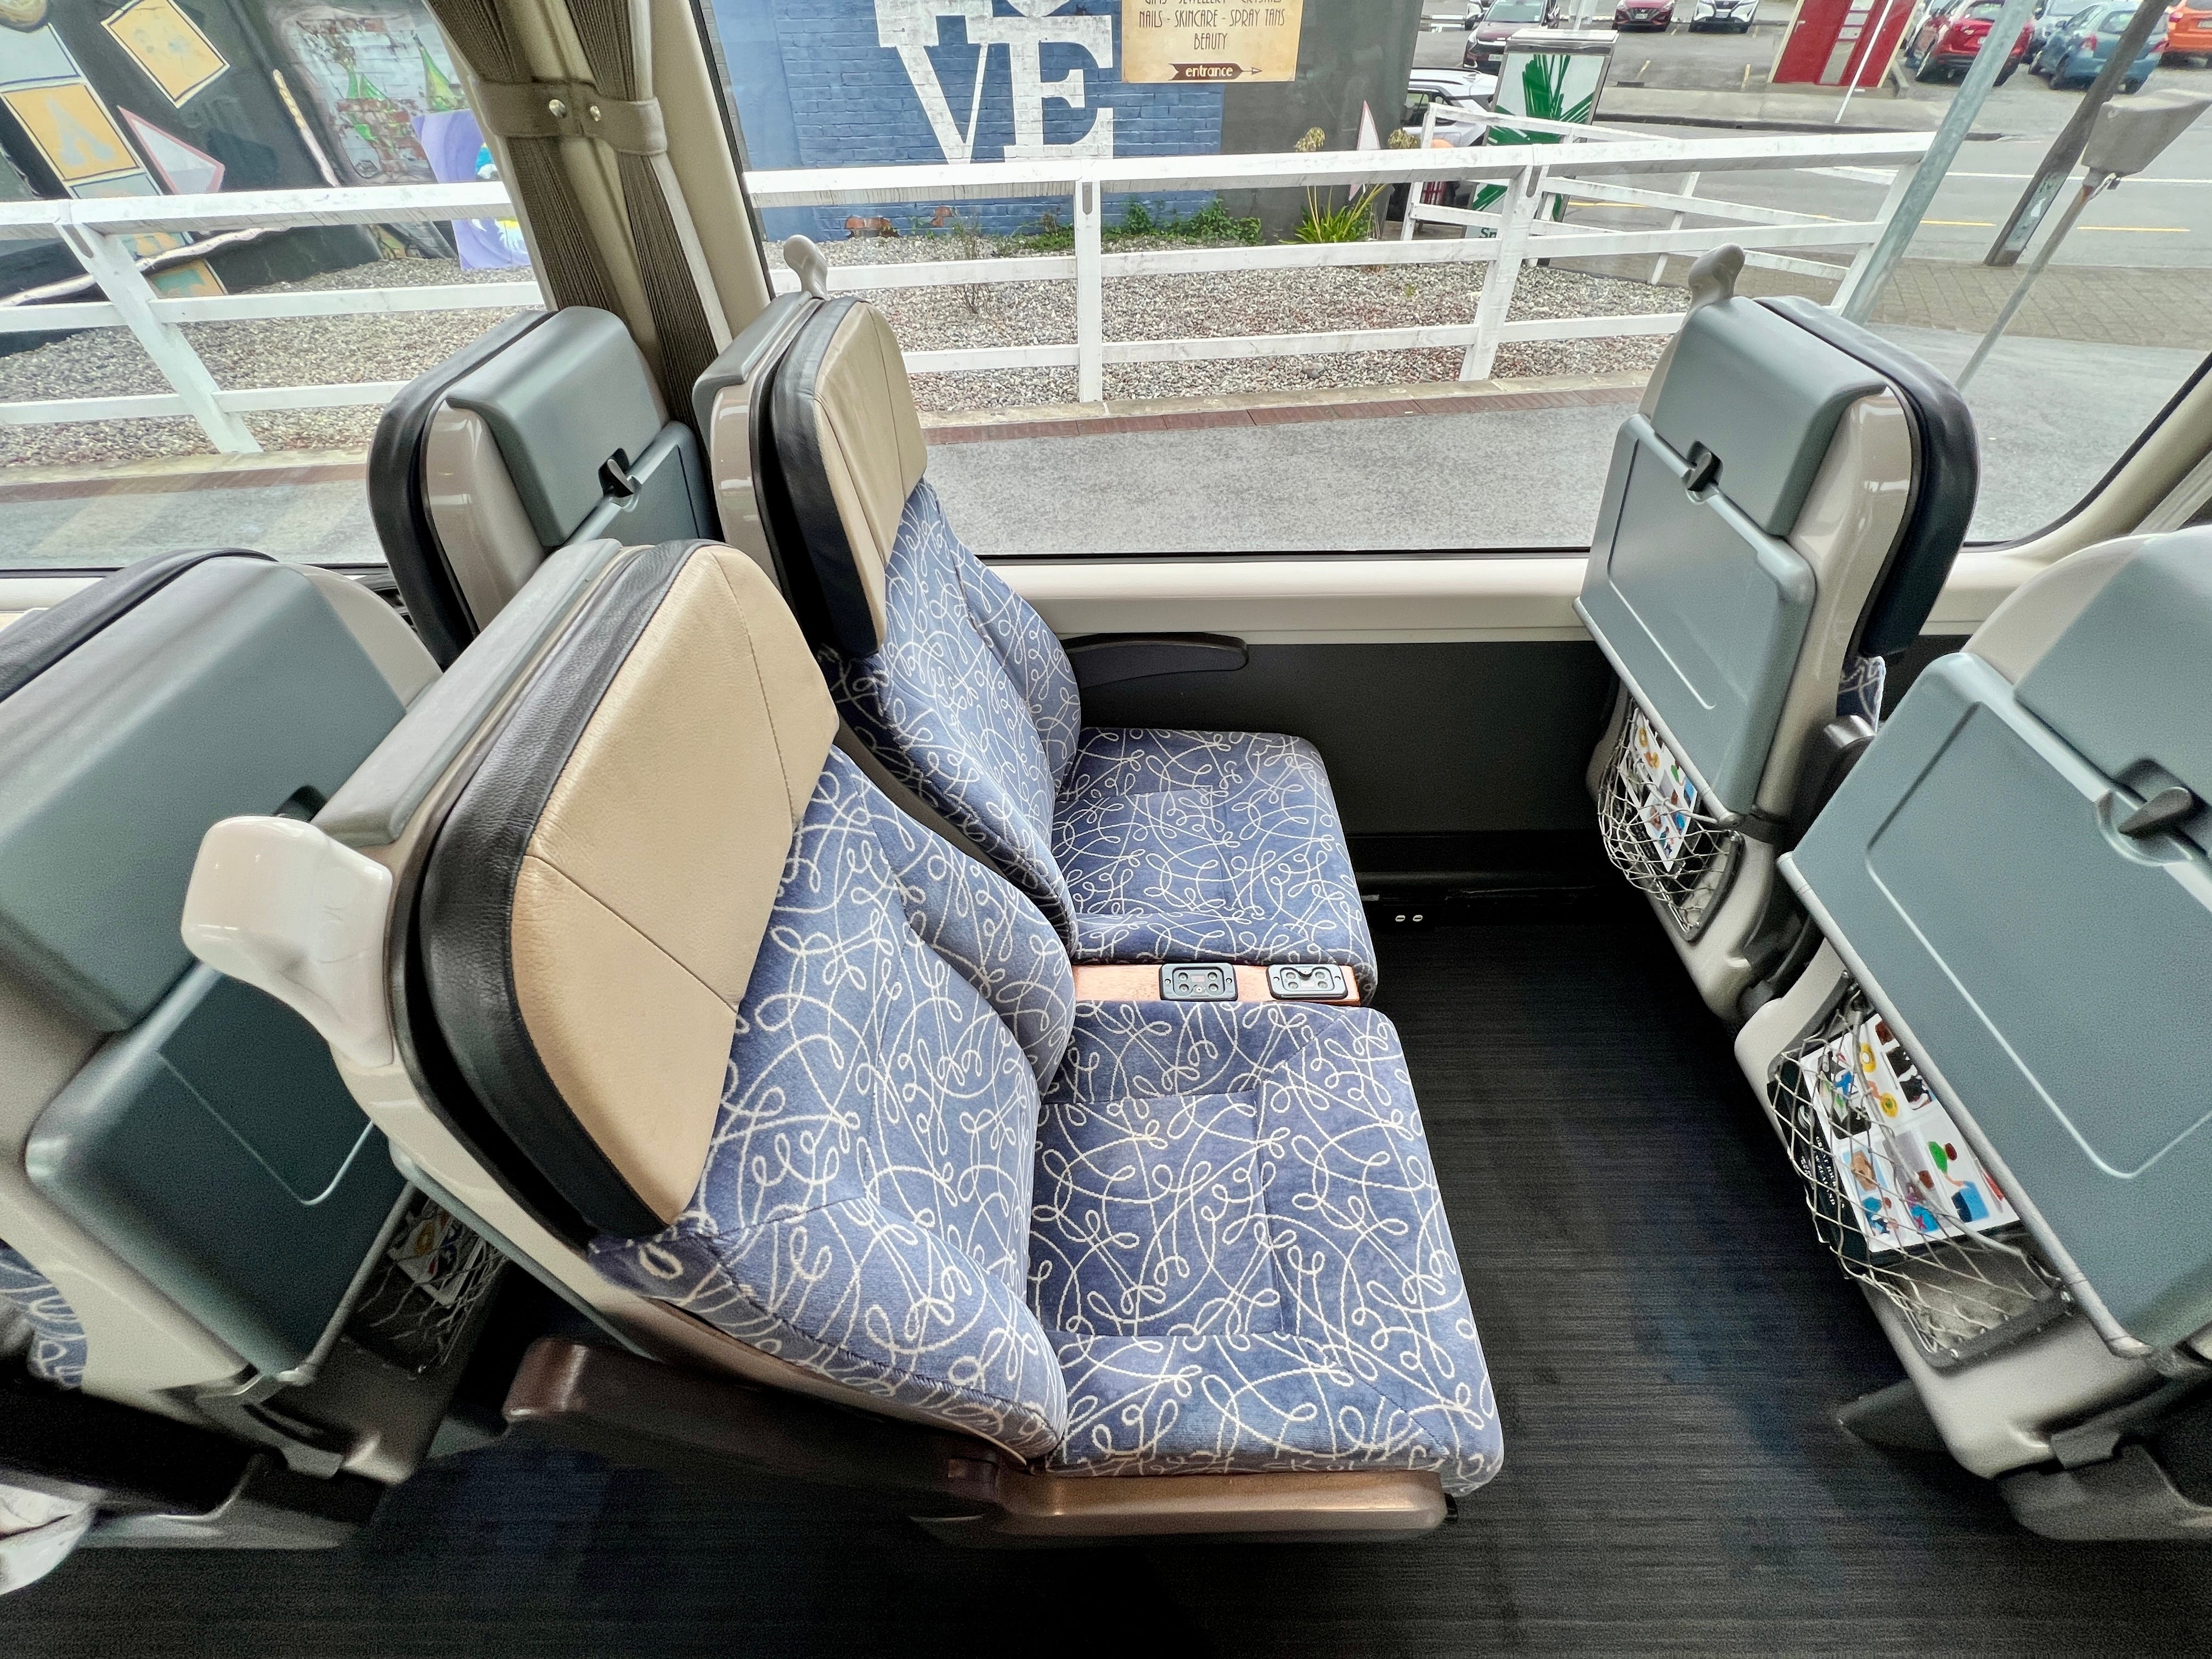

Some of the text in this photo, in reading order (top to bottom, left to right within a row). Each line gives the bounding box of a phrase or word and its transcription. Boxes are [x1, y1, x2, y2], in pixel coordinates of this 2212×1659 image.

[1139, 10, 1163, 27] NAILS
[1175, 9, 1218, 27] SKINCARE
[1229, 9, 1261, 27] SPRAY
[1265, 9, 1285, 26] TANS
[1194, 32, 1228, 50] BEAUTY
[1185, 65, 1233, 77] entrance
